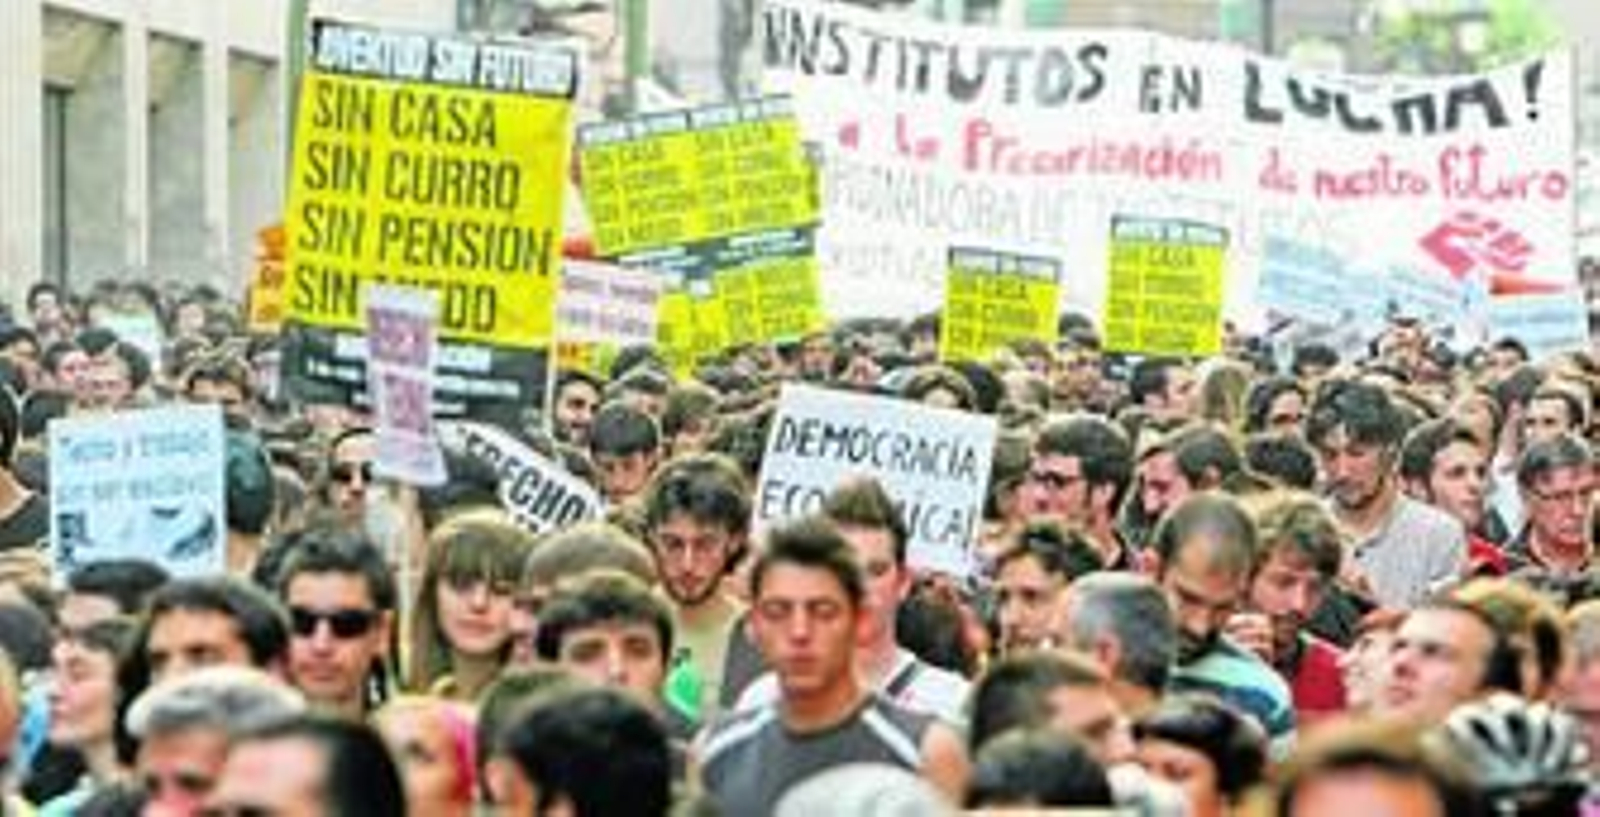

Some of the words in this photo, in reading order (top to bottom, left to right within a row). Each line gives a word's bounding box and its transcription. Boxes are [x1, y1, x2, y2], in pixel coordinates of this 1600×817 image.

[312, 79, 374, 134] SIN
[389, 89, 497, 148] CASA
[1140, 66, 1200, 114] EN
[303, 140, 371, 195] SIN
[384, 150, 520, 211] CURRO
[298, 203, 367, 258] SIN
[291, 263, 359, 317] SIN
